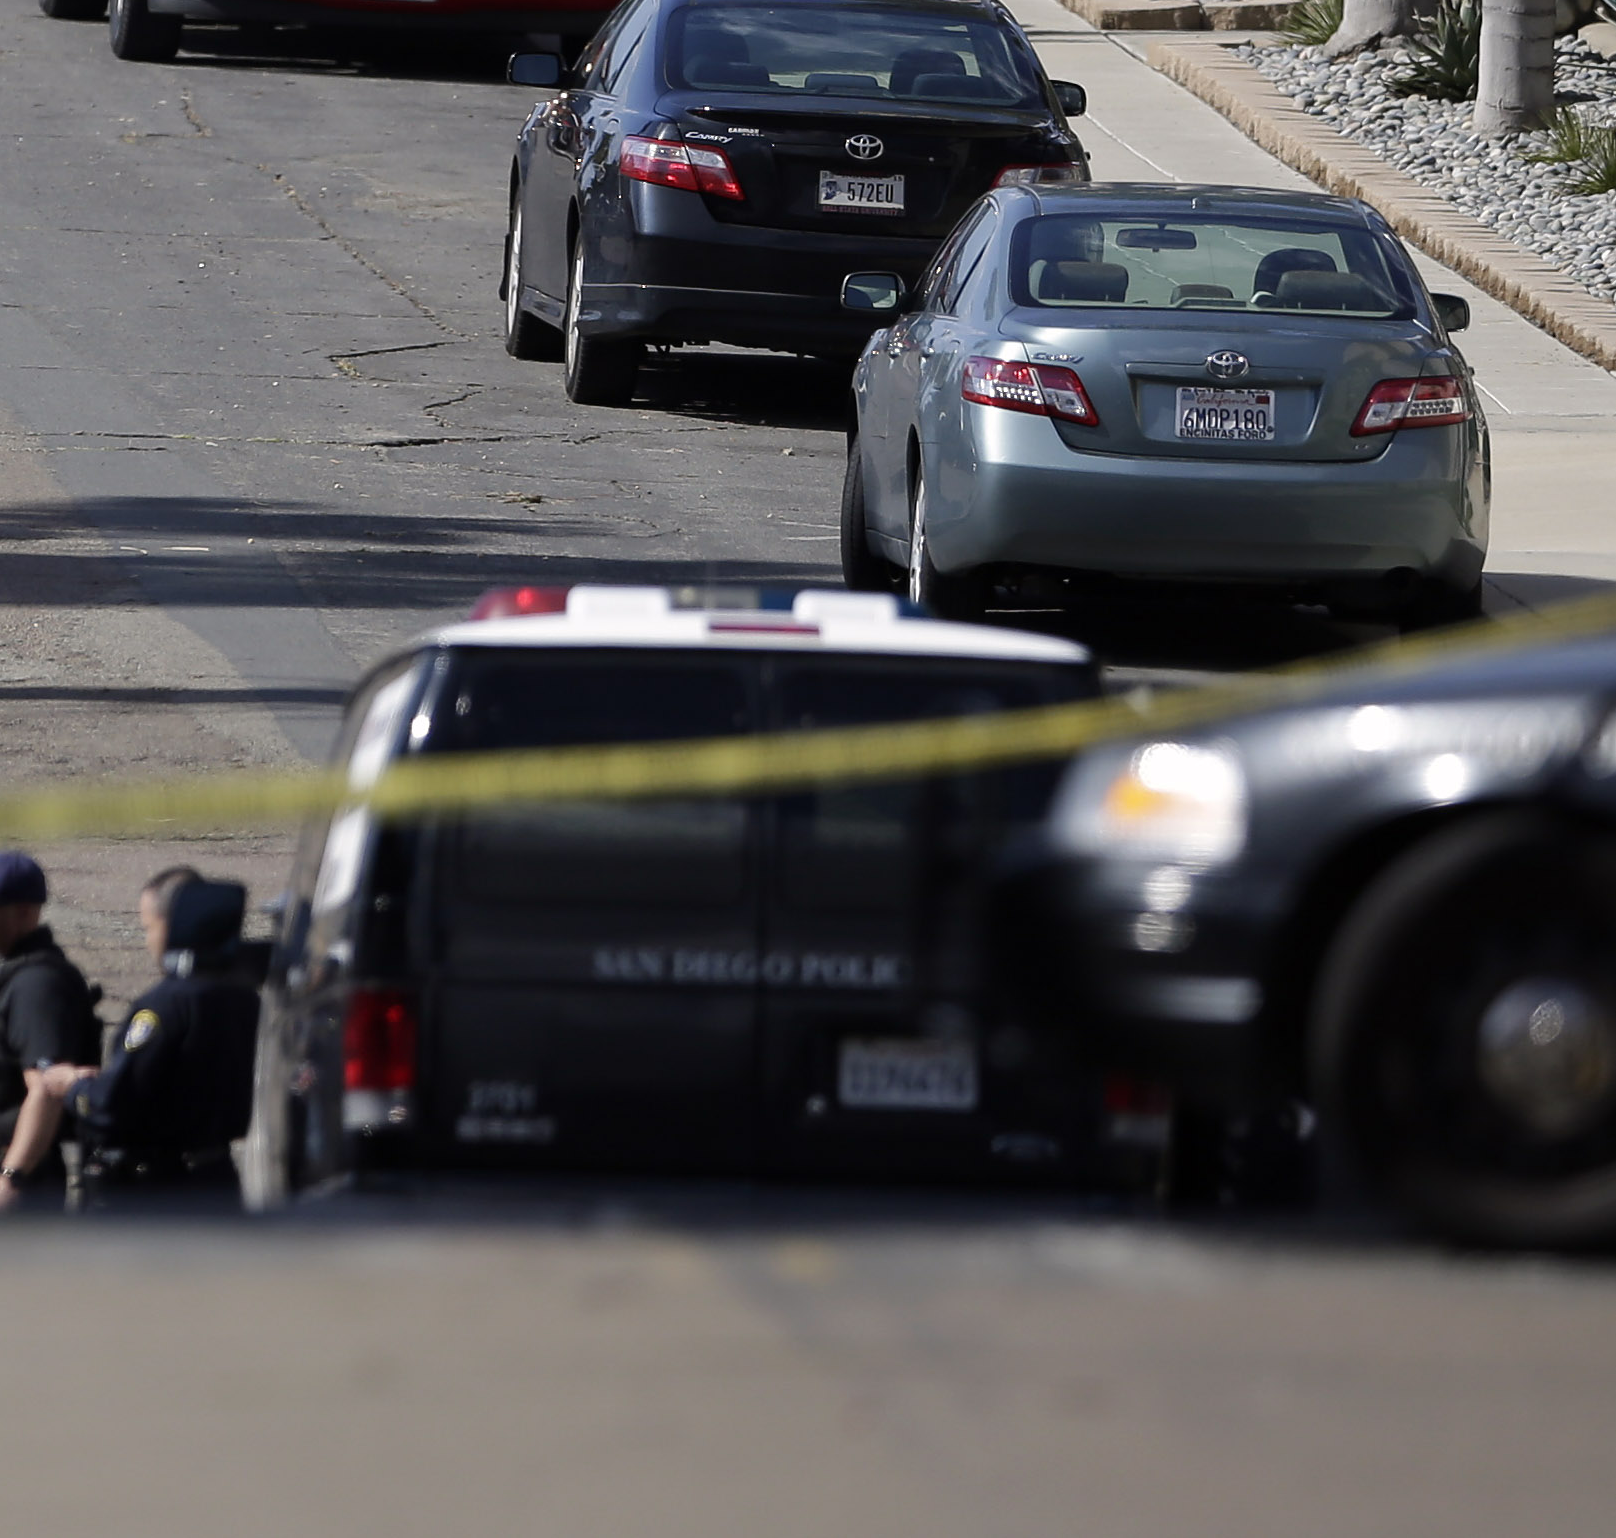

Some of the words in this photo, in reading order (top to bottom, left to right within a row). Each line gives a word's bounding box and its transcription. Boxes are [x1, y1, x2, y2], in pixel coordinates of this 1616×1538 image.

[685, 131, 733, 144] Camry
[847, 182, 894, 203] 572EU
[1179, 428, 1235, 439] ENCINITAS
[1237, 430, 1266, 440] FORD
[593, 947, 663, 983] SAN
[671, 948, 793, 986] DIEGO
[798, 953, 910, 989] POLIC
